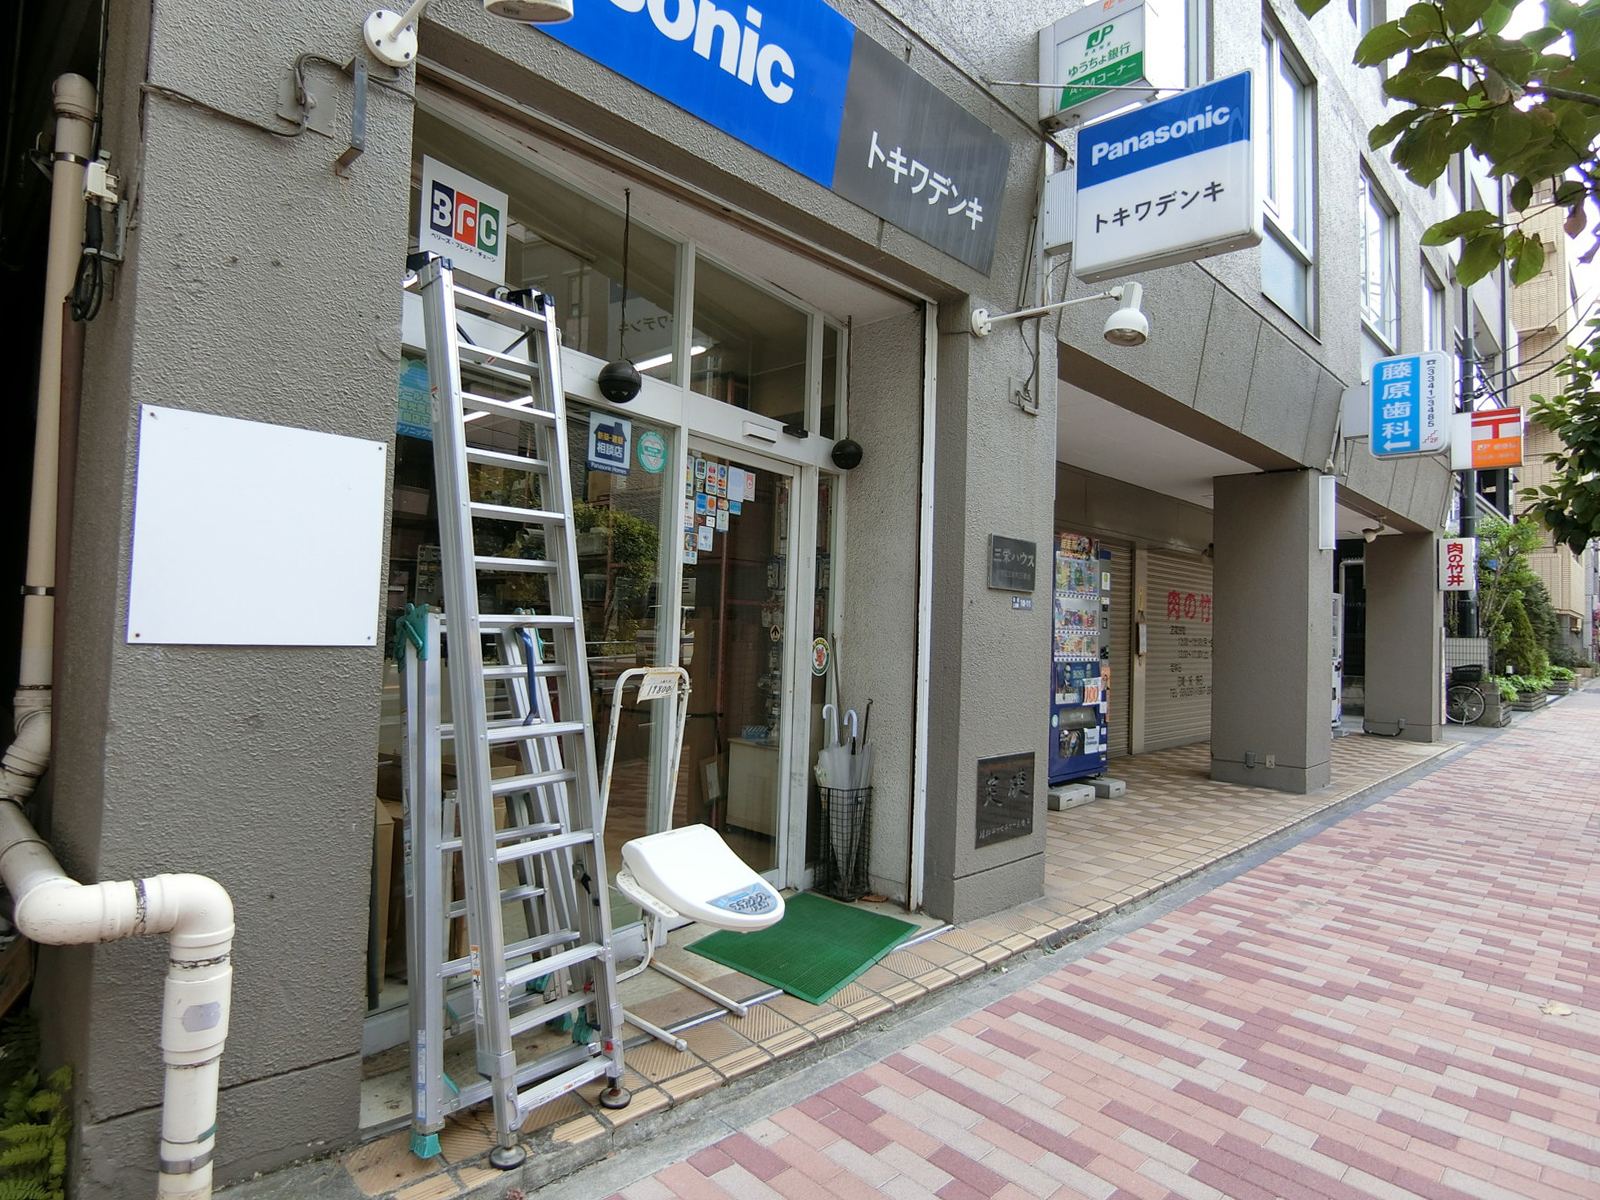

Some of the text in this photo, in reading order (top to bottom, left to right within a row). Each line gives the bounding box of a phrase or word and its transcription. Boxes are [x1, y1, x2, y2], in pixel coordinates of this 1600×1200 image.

[1068, 41, 1131, 78] ゆうちょ銀行
[1092, 105, 1230, 166] Panasonic
[868, 131, 983, 231] トキワデンキ
[1096, 181, 1224, 233] トキワデンキ
[1382, 361, 1412, 439] 藤原歯科
[590, 461, 613, 472] Panasonic
[993, 548, 1035, 567] 三栄ハウス
[1447, 543, 1465, 587] 肉の竹井
